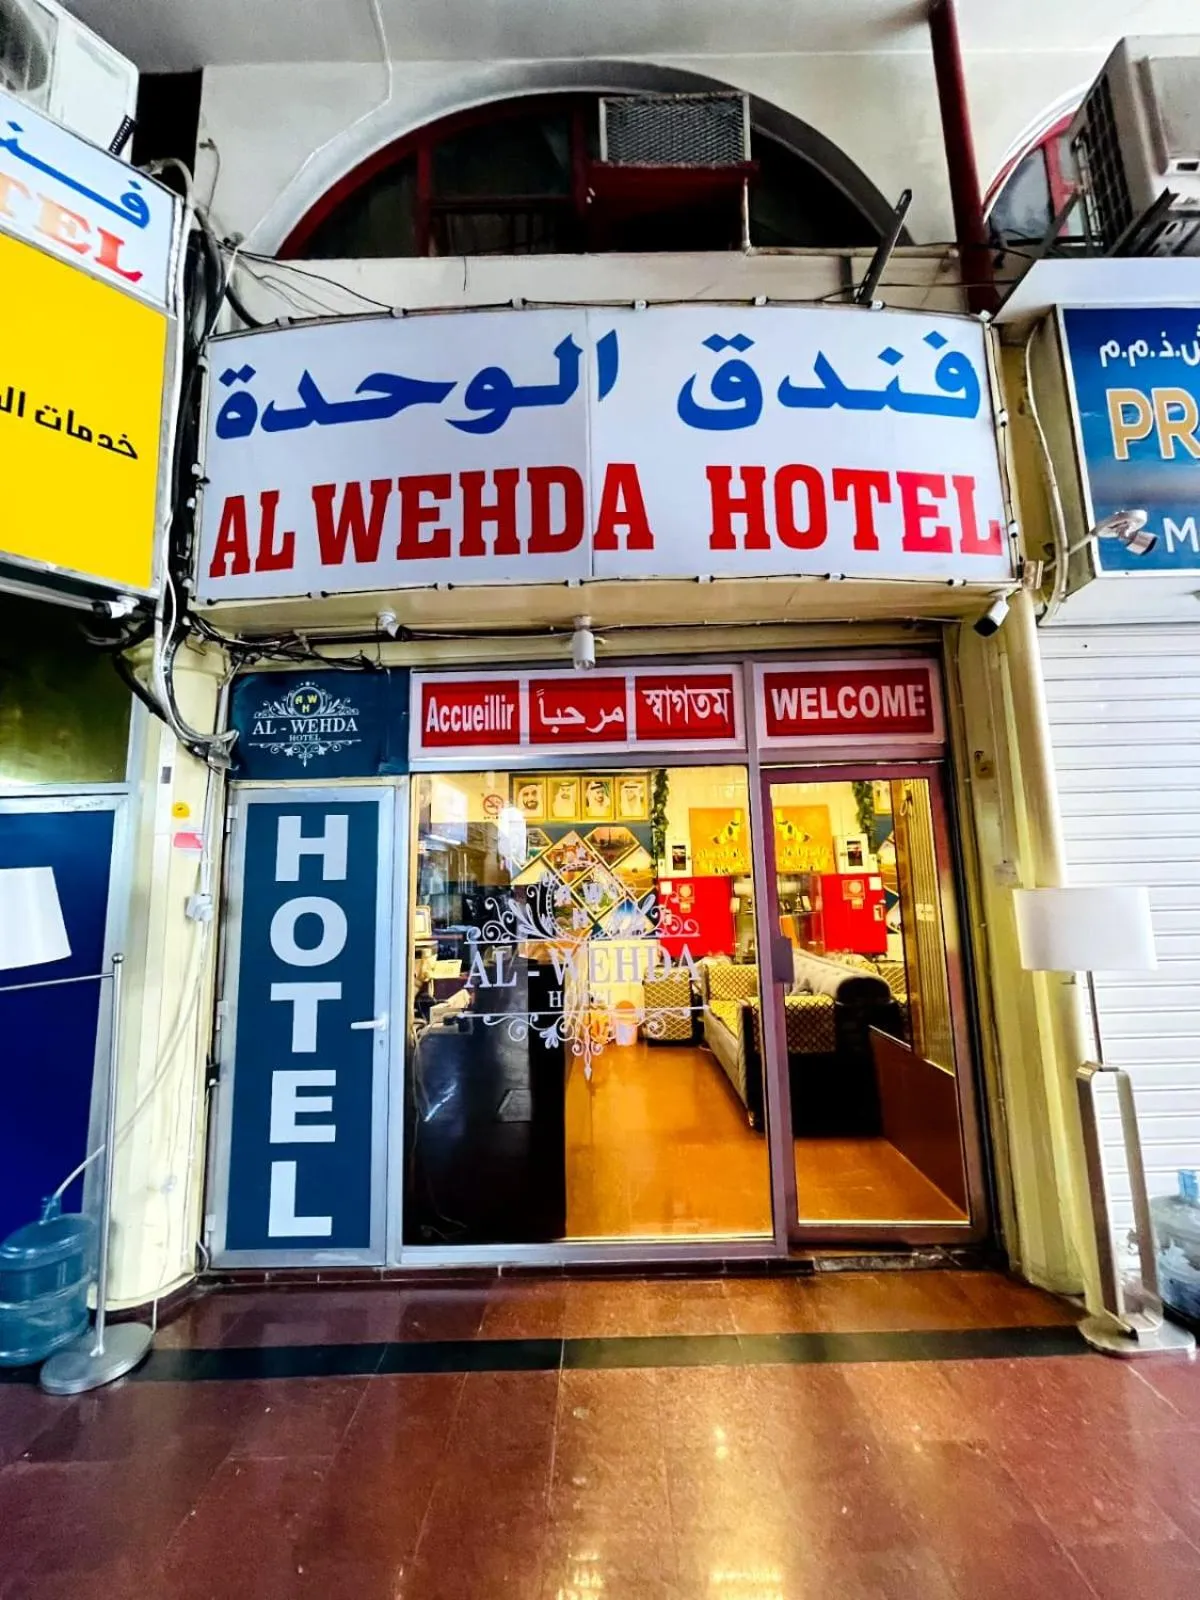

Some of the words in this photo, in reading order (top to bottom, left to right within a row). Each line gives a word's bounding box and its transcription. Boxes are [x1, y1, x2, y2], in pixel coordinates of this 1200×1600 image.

[0, 120, 150, 229] فن
[0, 386, 26, 418] ال
[216, 329, 619, 440] الوحدة
[677, 330, 981, 431] فندق
[34, 404, 138, 460] خدمات
[1105, 386, 1200, 461] PR
[209, 490, 295, 578] AL
[312, 463, 654, 566] WEHDA
[705, 463, 1003, 556] HOTEL
[1162, 516, 1199, 553] M
[426, 693, 515, 733] Accueillir
[641, 684, 733, 725] স্বাগতম
[771, 684, 926, 721] WELCOME
[289, 734, 322, 742] HOTEL
[290, 717, 359, 734] WEHDA
[549, 943, 702, 986] WEHDA
[268, 814, 349, 1237] HOTEL
